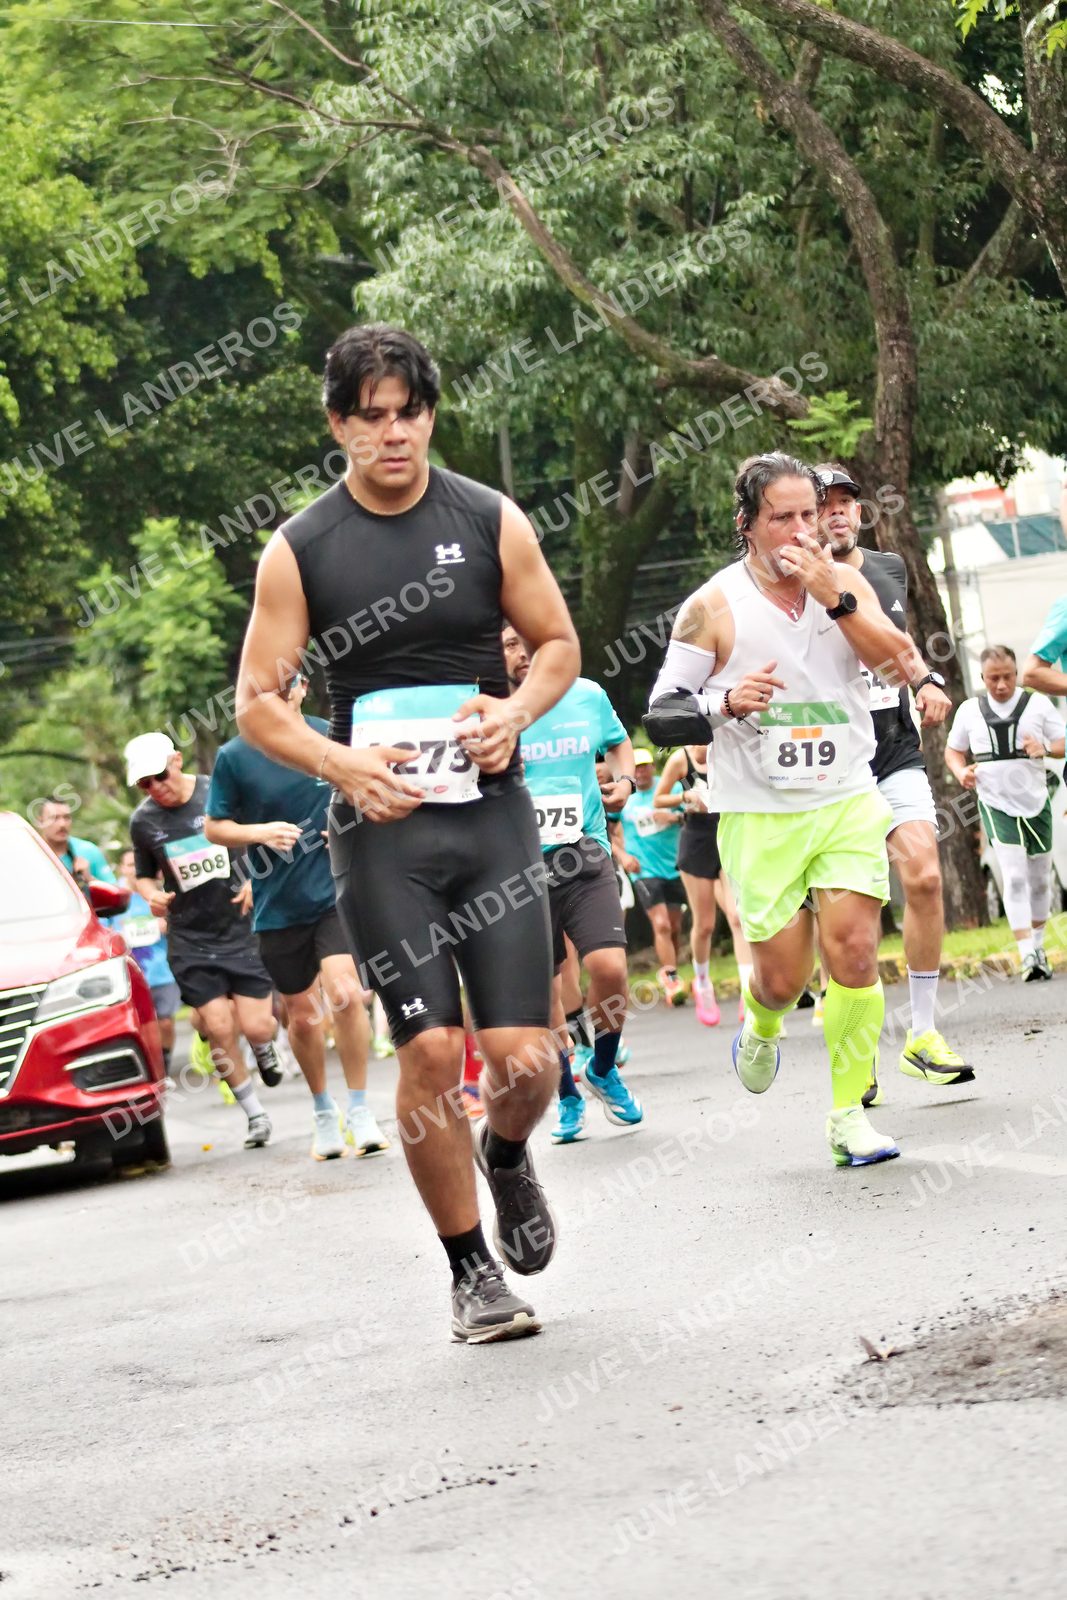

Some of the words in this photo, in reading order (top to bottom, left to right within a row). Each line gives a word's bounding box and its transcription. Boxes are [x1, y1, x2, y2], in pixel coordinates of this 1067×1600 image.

[369, 740, 473, 775] 273
[778, 740, 836, 767] 819
[178, 854, 225, 880] 5908
